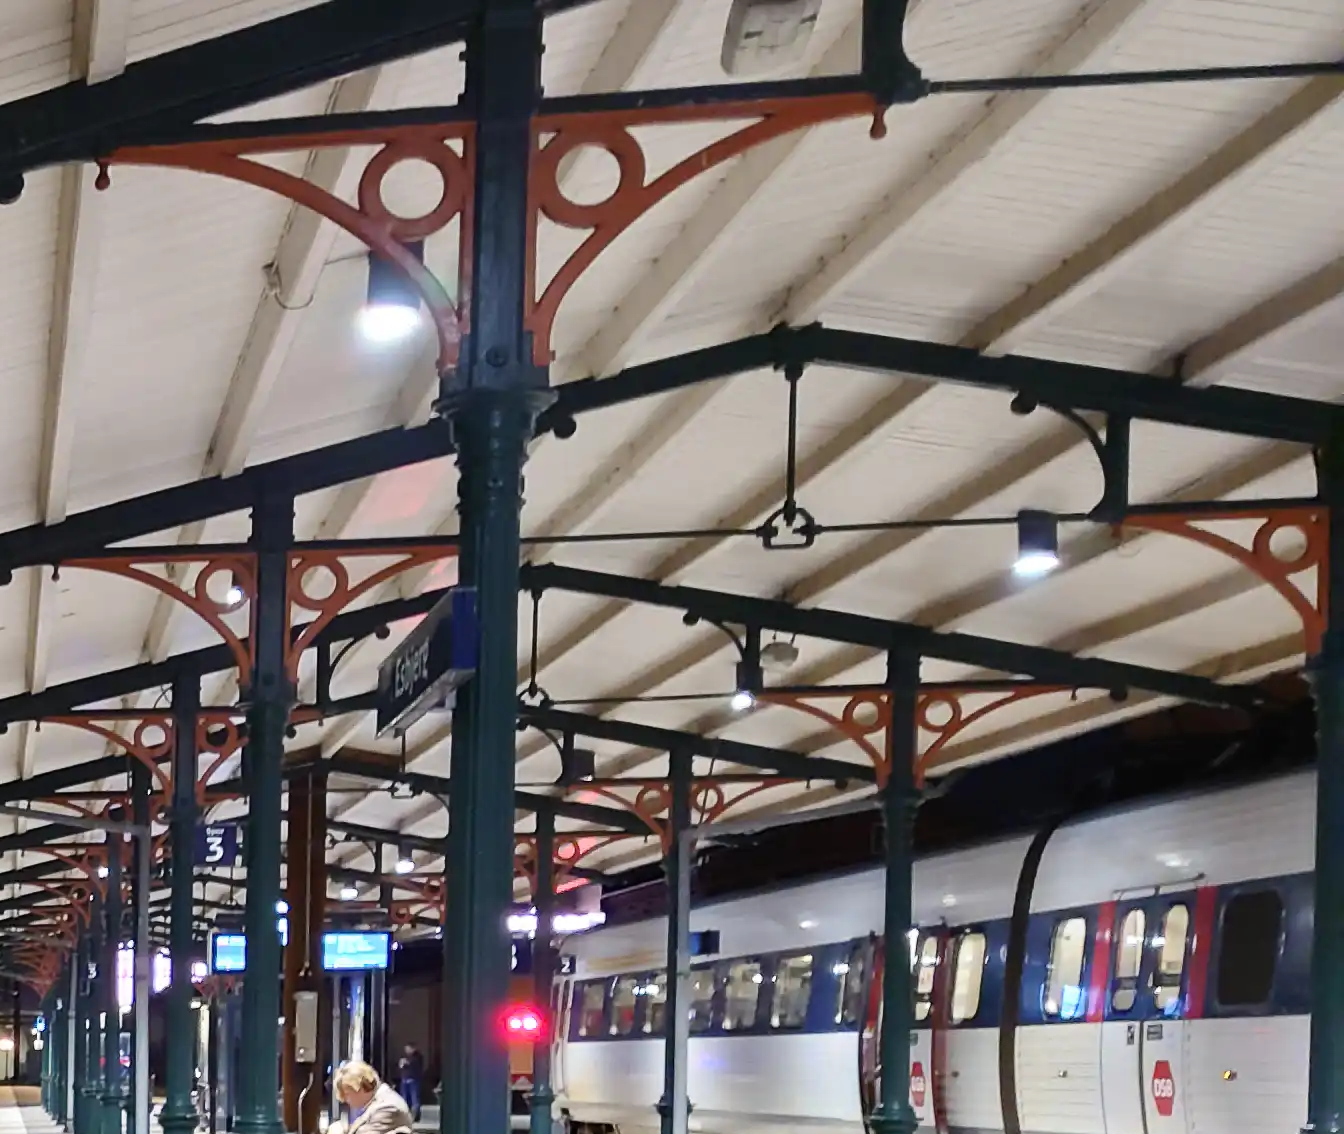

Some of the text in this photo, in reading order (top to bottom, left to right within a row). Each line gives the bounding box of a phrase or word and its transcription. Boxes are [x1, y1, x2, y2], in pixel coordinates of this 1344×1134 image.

[394, 637, 430, 698] Esbjerg
[205, 837, 224, 863] 3
[561, 960, 571, 973] 2
[1153, 1078, 1173, 1098] DSB
